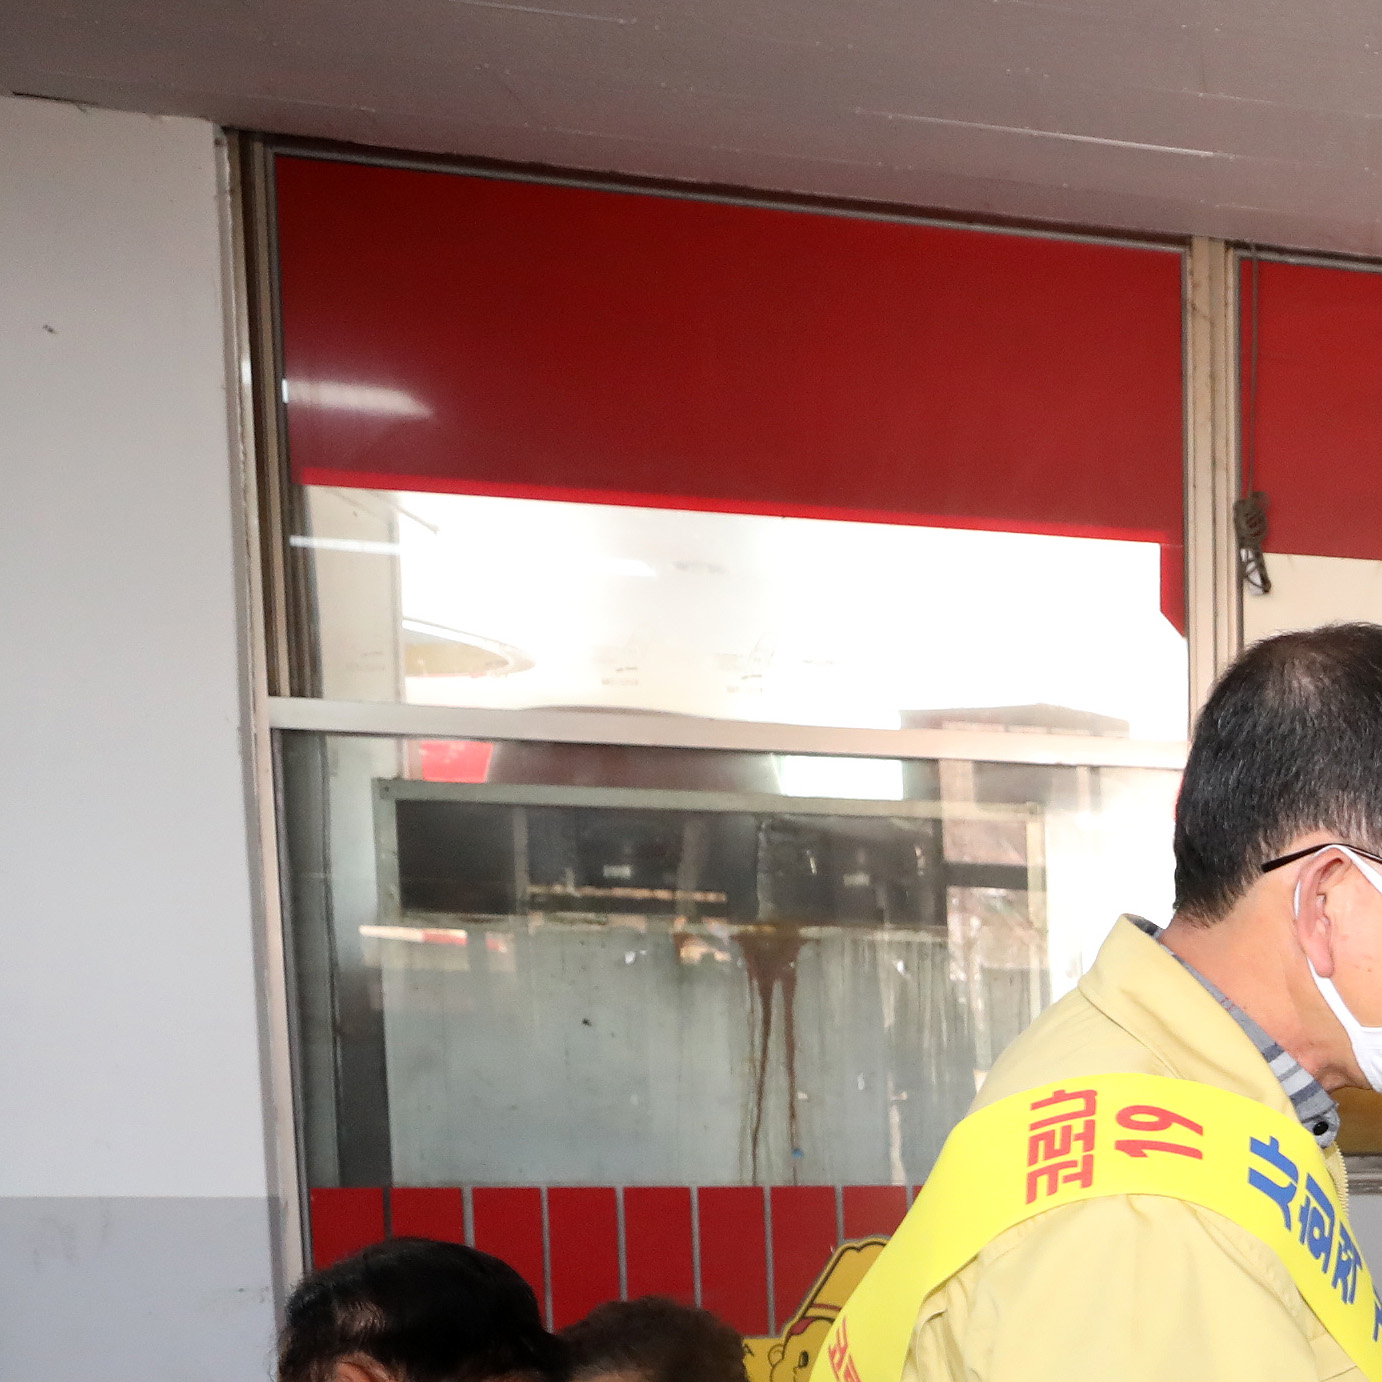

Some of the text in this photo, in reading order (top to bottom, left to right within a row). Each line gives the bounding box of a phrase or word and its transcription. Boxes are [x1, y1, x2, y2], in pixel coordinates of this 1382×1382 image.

[1026, 1089, 1098, 1205] 코로나
[1114, 1104, 1203, 1160] 19
[1248, 1135, 1363, 1305] 사회적
